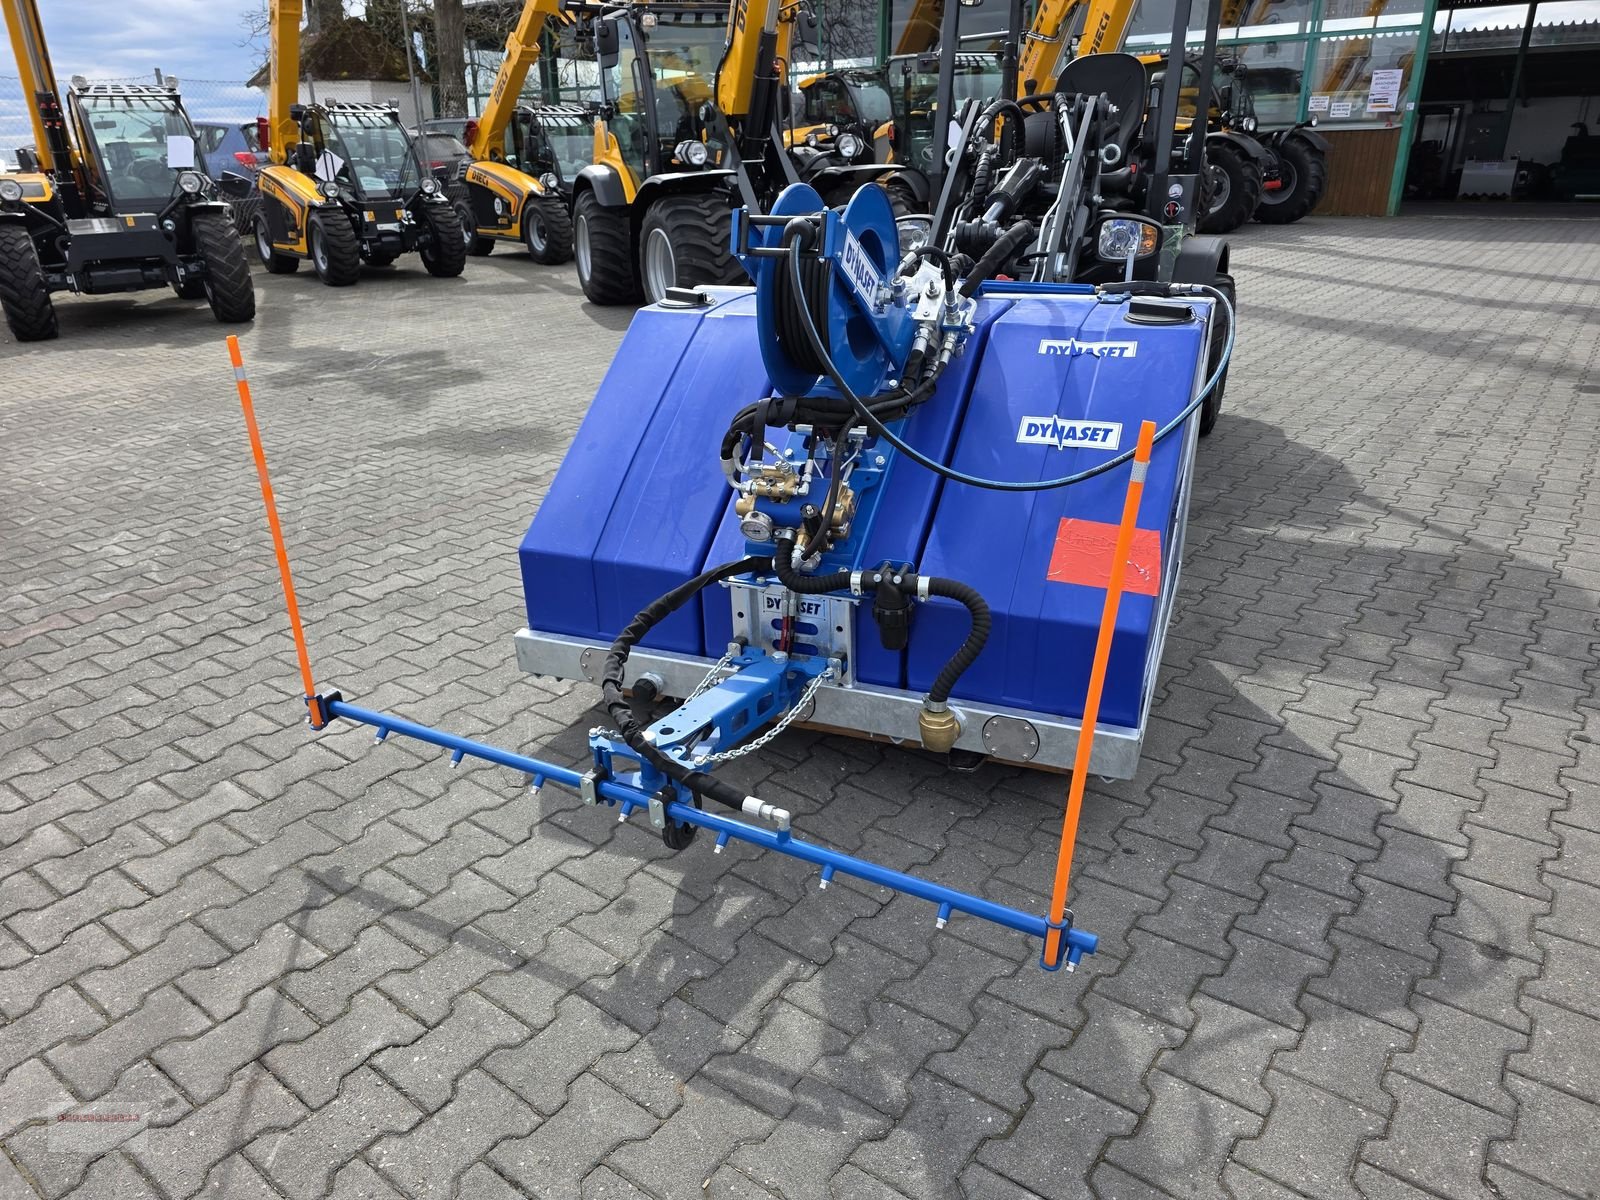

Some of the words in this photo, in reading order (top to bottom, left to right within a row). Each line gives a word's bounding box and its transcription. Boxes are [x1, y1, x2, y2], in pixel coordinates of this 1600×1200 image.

[472, 170, 489, 187] DIECI
[845, 242, 876, 297] DYNASET
[1026, 417, 1113, 446] DYNASET
[766, 596, 821, 615] DYSET
